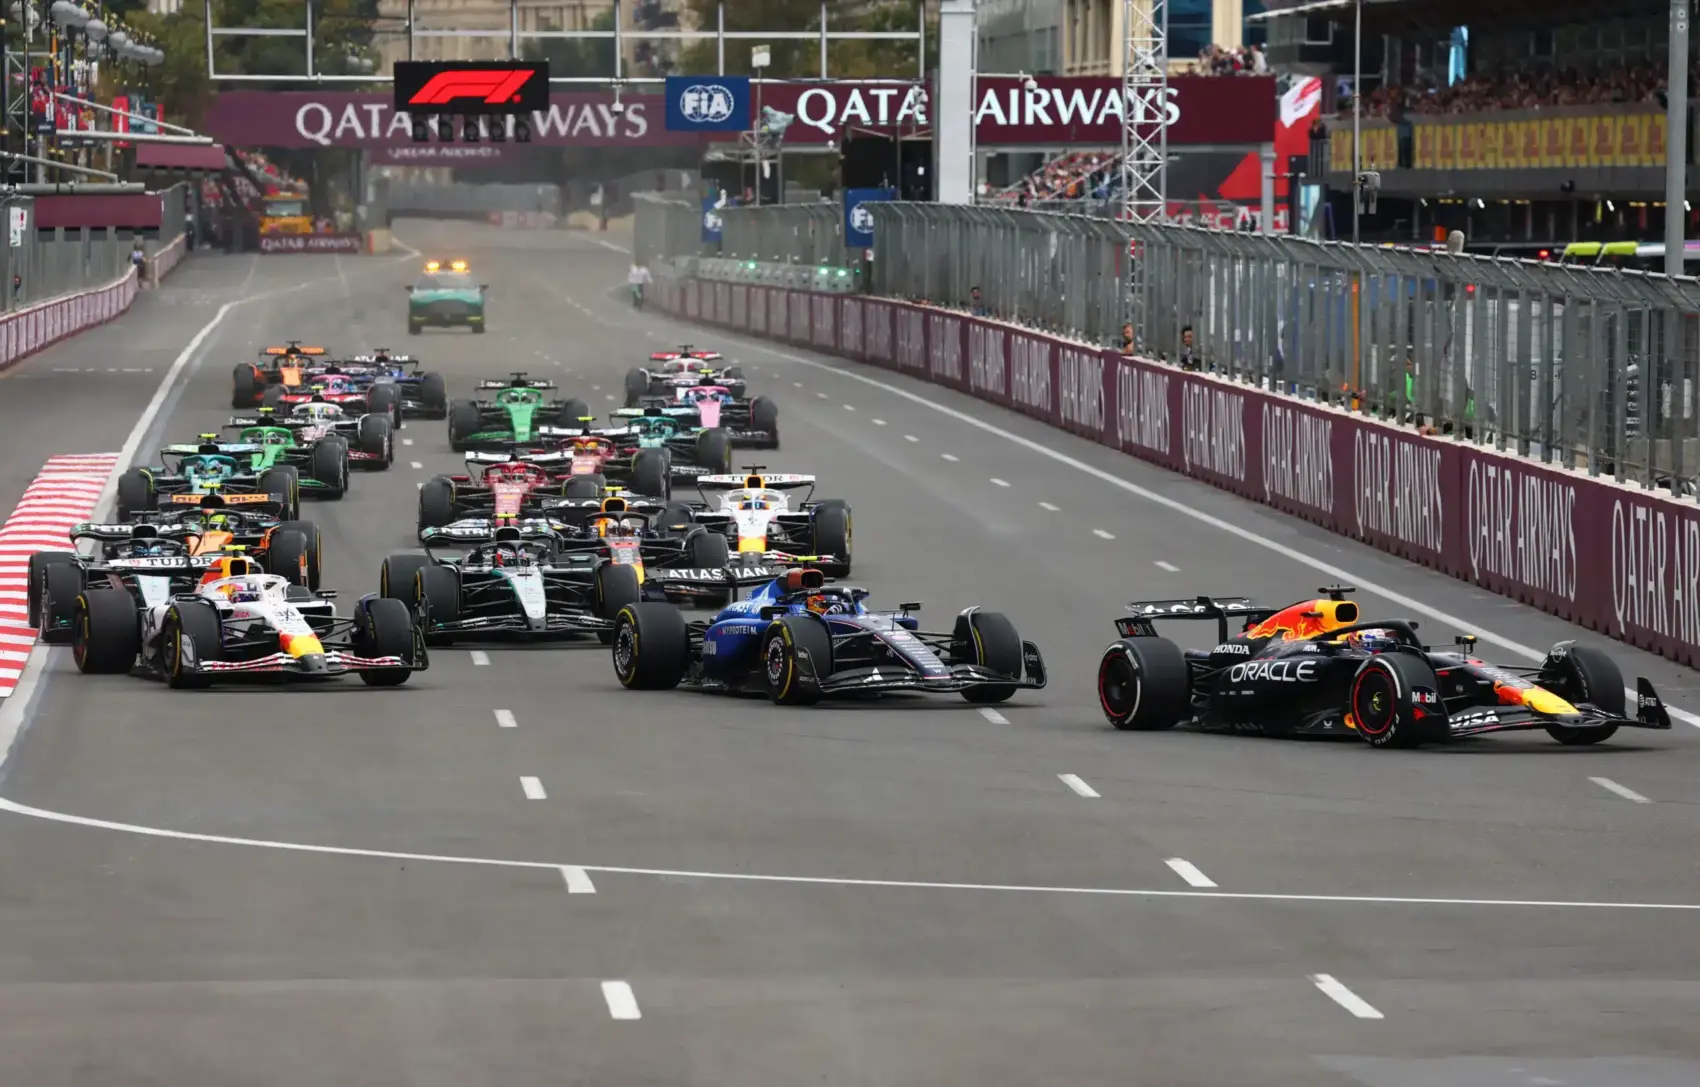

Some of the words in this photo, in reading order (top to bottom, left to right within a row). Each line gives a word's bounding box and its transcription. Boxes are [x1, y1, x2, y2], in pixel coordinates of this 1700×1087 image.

[797, 88, 929, 134] QATA
[1262, 401, 1293, 501] QATAR
[1295, 409, 1333, 514] AIRWAYS
[1354, 427, 1391, 537] QATAR
[1393, 437, 1442, 554] AIRWAYS
[1469, 458, 1513, 580] QATAR
[1516, 471, 1576, 603] AIRWAYS
[669, 567, 769, 580] ATLASIAN
[1612, 498, 1669, 636] QATAR
[1213, 644, 1250, 655] HONDA
[1231, 661, 1319, 683] ORACLE
[1411, 691, 1437, 704] Mobil
